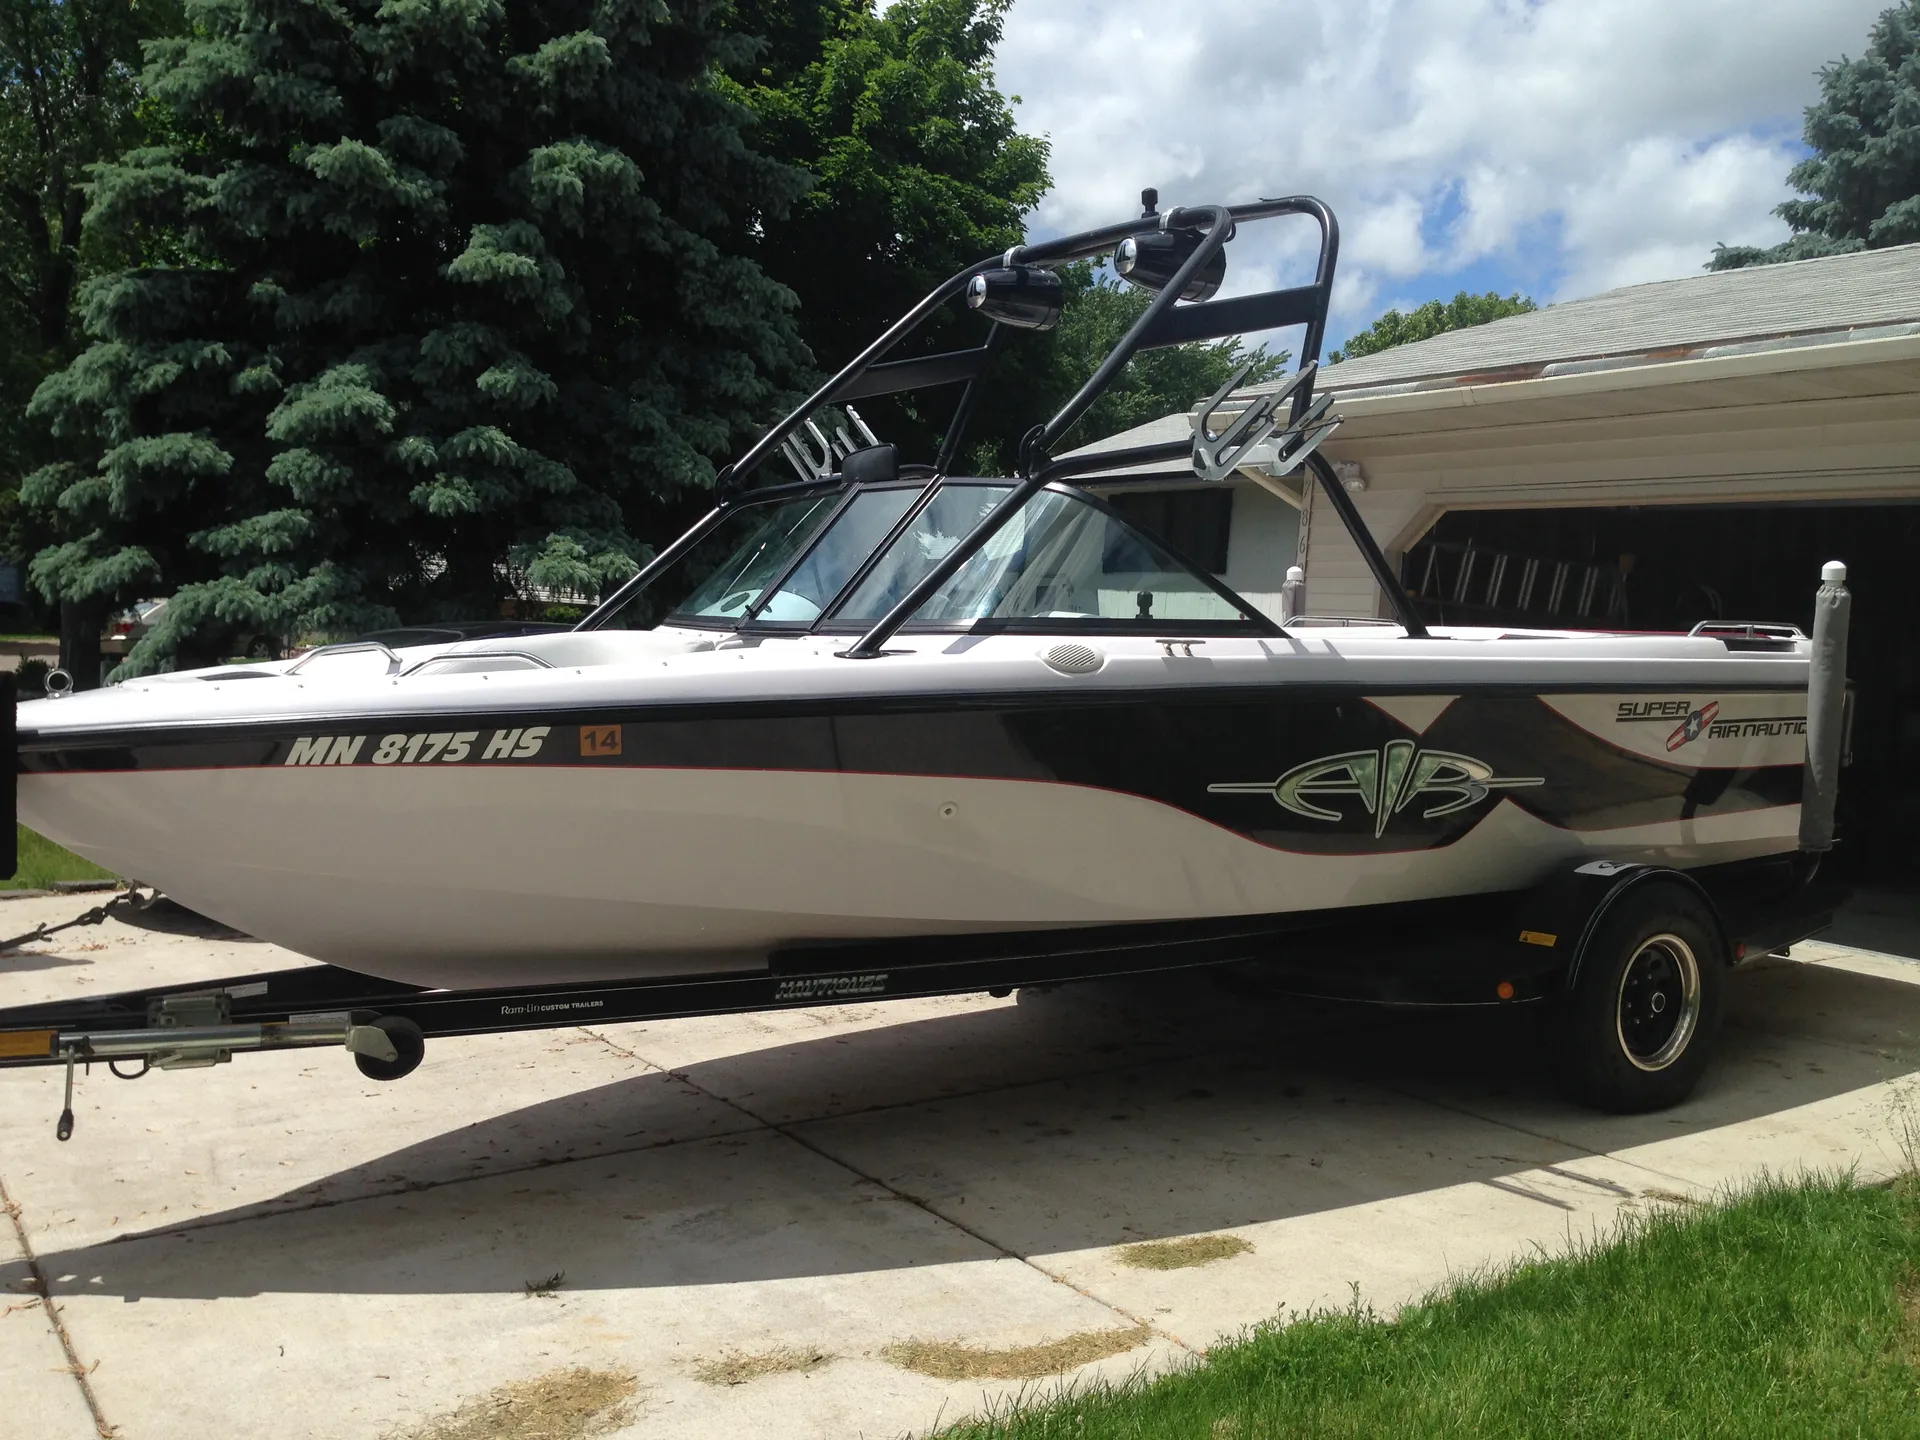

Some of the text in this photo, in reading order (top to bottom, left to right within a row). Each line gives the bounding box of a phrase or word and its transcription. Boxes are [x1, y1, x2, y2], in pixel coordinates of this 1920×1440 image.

[1618, 701, 1691, 716] SUPER
[584, 729, 619, 752] 14
[1708, 724, 1741, 739] AIR
[285, 726, 551, 765] MN 8175 HS
[775, 974, 888, 999] NAUTIQUES
[540, 1003, 570, 1012] CUSTOM
[571, 1000, 604, 1010] TRAILERS
